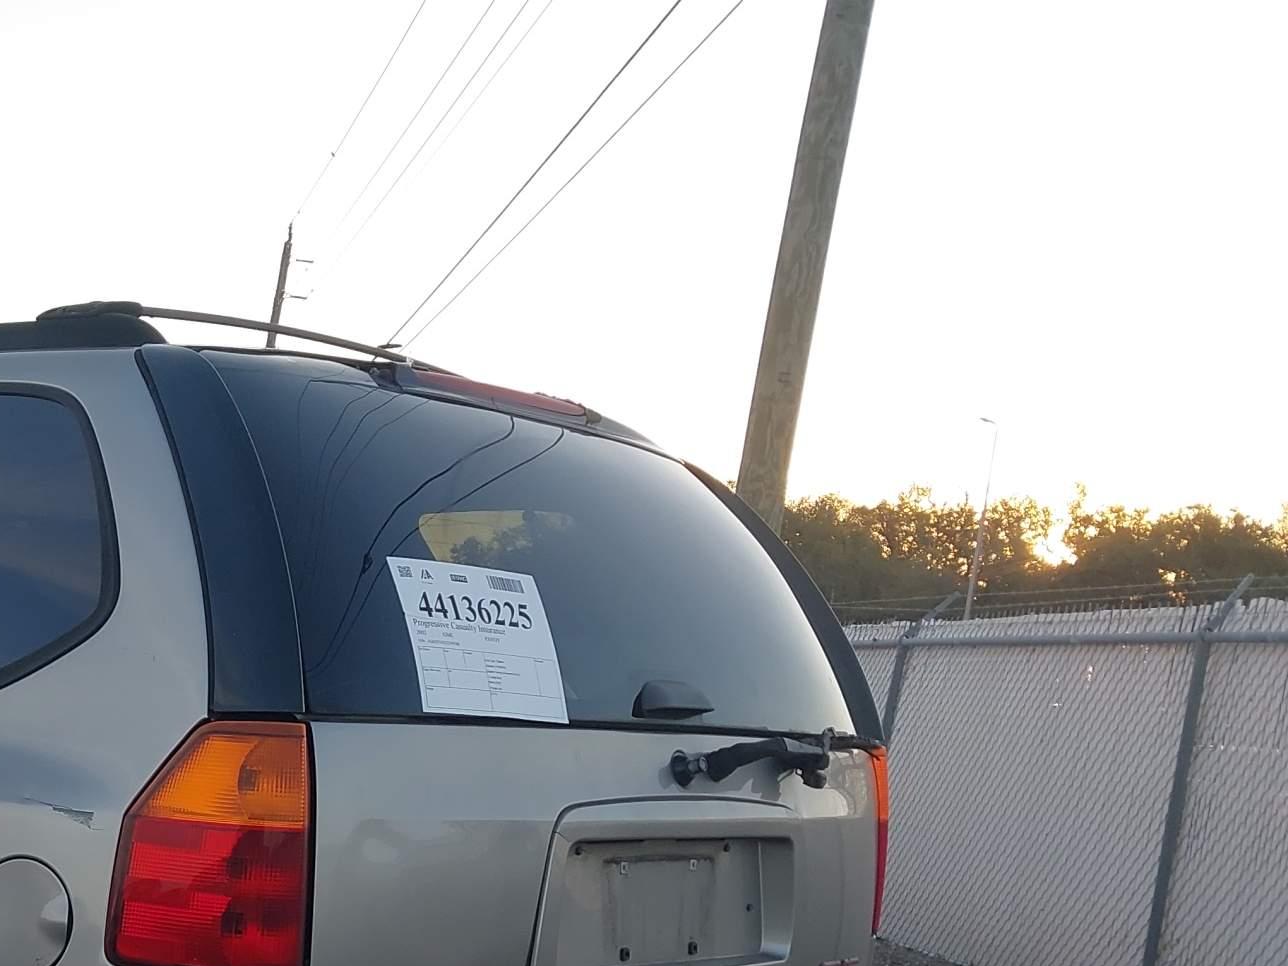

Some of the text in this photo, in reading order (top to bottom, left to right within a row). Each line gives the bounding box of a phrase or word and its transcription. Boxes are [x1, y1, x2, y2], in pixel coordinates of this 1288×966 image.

[419, 591, 533, 629] 44136225
[413, 618, 506, 635] Progressive Casualty Insurance
